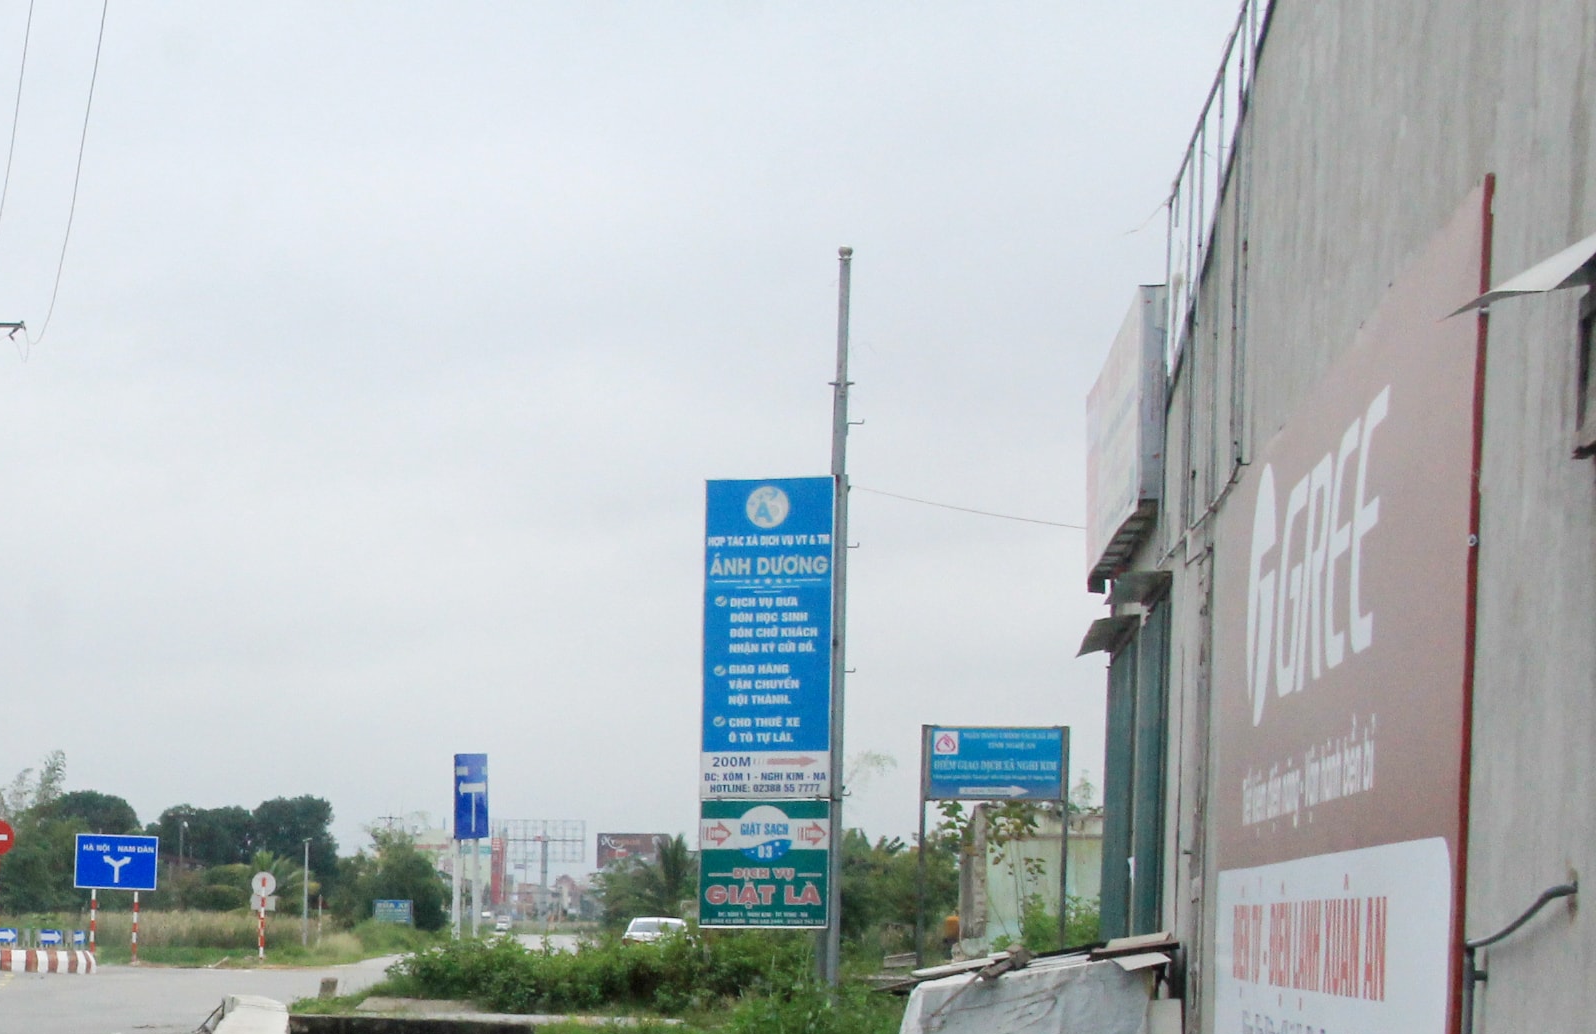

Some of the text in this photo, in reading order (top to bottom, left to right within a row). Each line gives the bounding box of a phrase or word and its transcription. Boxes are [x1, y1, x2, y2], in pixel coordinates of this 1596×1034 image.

[1276, 385, 1391, 698] GREE
[710, 552, 828, 576] ÁNH DƯƠNG
[730, 597, 756, 609] DỊCH
[758, 597, 773, 609] VỤ
[756, 611, 778, 624] HỌC
[781, 611, 808, 622] SINH
[781, 625, 818, 637] KHÁCH
[729, 641, 759, 654] NHẬN
[729, 663, 790, 675] GIAO HÀNG
[729, 677, 752, 691] VẬN
[728, 693, 748, 706] NỘI
[729, 716, 800, 728] CHO THUÊ XE
[729, 731, 737, 743] Ô
[740, 731, 753, 743] TÔ
[756, 731, 771, 744] TỰ
[712, 757, 751, 767] 200M
[957, 761, 978, 770] GIAO
[980, 761, 1002, 773] DỊCH
[1017, 761, 1038, 770] NGHI
[1040, 761, 1057, 770] KIM
[722, 771, 743, 781] XÓM
[747, 772, 750, 781] 1
[760, 772, 783, 781] NGHI
[786, 772, 803, 781] KIM
[813, 772, 826, 781] NA
[710, 783, 750, 793] HOTLINE:
[784, 783, 795, 792] 55
[798, 783, 820, 792] 7777
[764, 823, 789, 837] SẠCH
[117, 845, 136, 853] NAM
[758, 845, 772, 858] 03
[732, 867, 795, 881] DỊCH VỤ
[705, 881, 822, 909] GIẶT LÀ
[1293, 900, 1321, 1010] LẠNH
[1323, 873, 1360, 998] XUÂN
[1363, 896, 1387, 1002] AN
